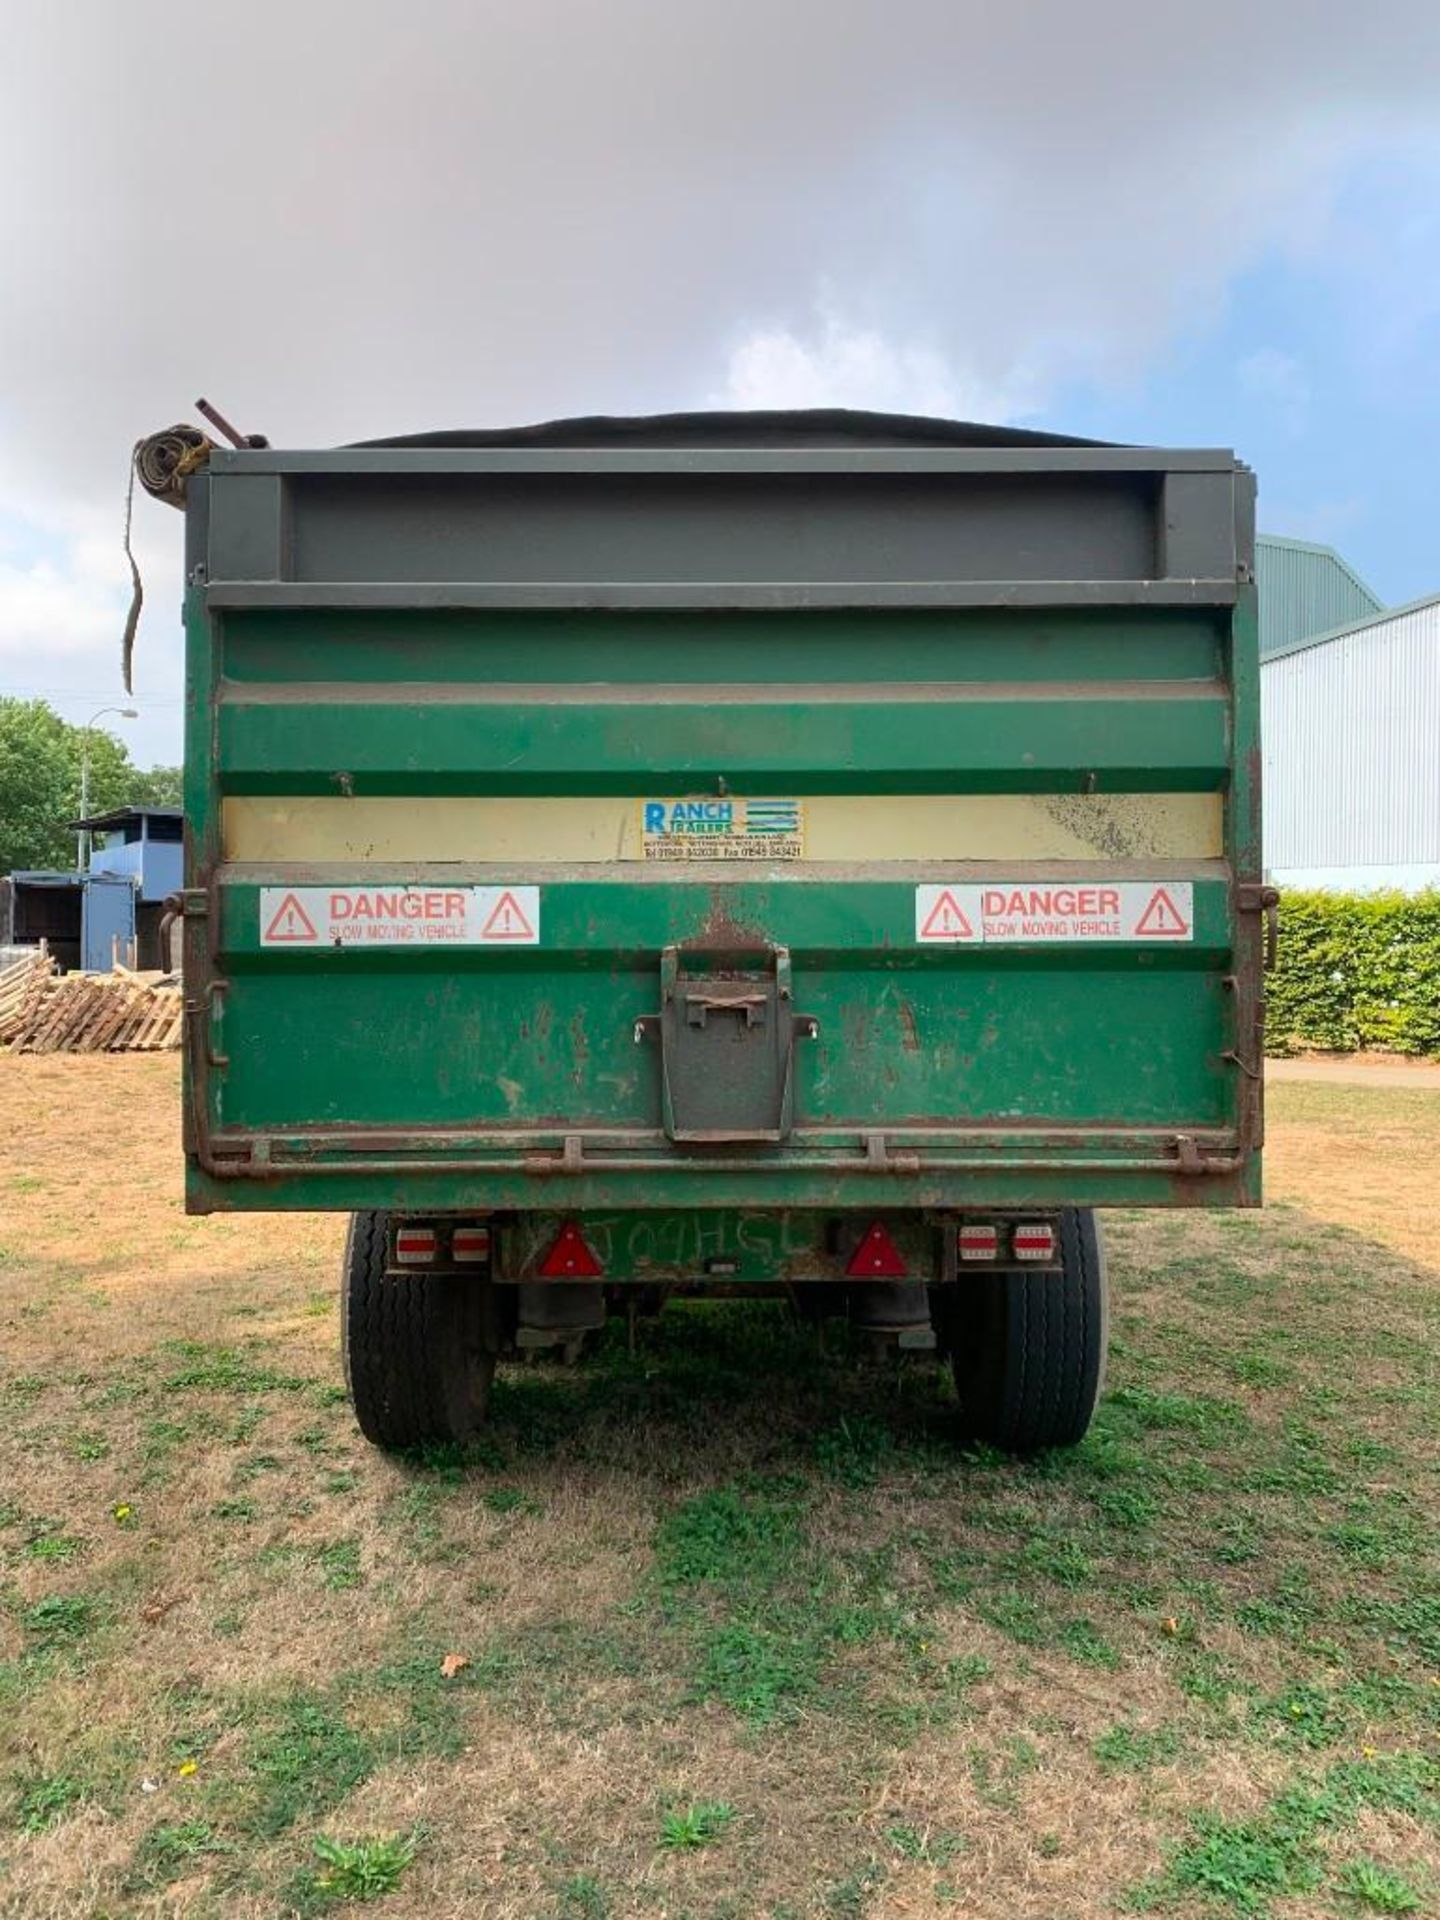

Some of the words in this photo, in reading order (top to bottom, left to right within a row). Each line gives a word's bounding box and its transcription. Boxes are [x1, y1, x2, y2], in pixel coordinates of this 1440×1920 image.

[645, 802, 733, 834] RANCH
[670, 821, 735, 834] TRAILERS
[329, 892, 466, 920] DANGER
[983, 890, 1120, 917] DANGER
[329, 925, 361, 940] SLOW
[366, 925, 415, 940] MOVING
[419, 924, 467, 939] VEHICLE
[983, 922, 1016, 937] SLOW
[1022, 922, 1067, 937] MOVING
[1072, 921, 1121, 936] VEHICLE
